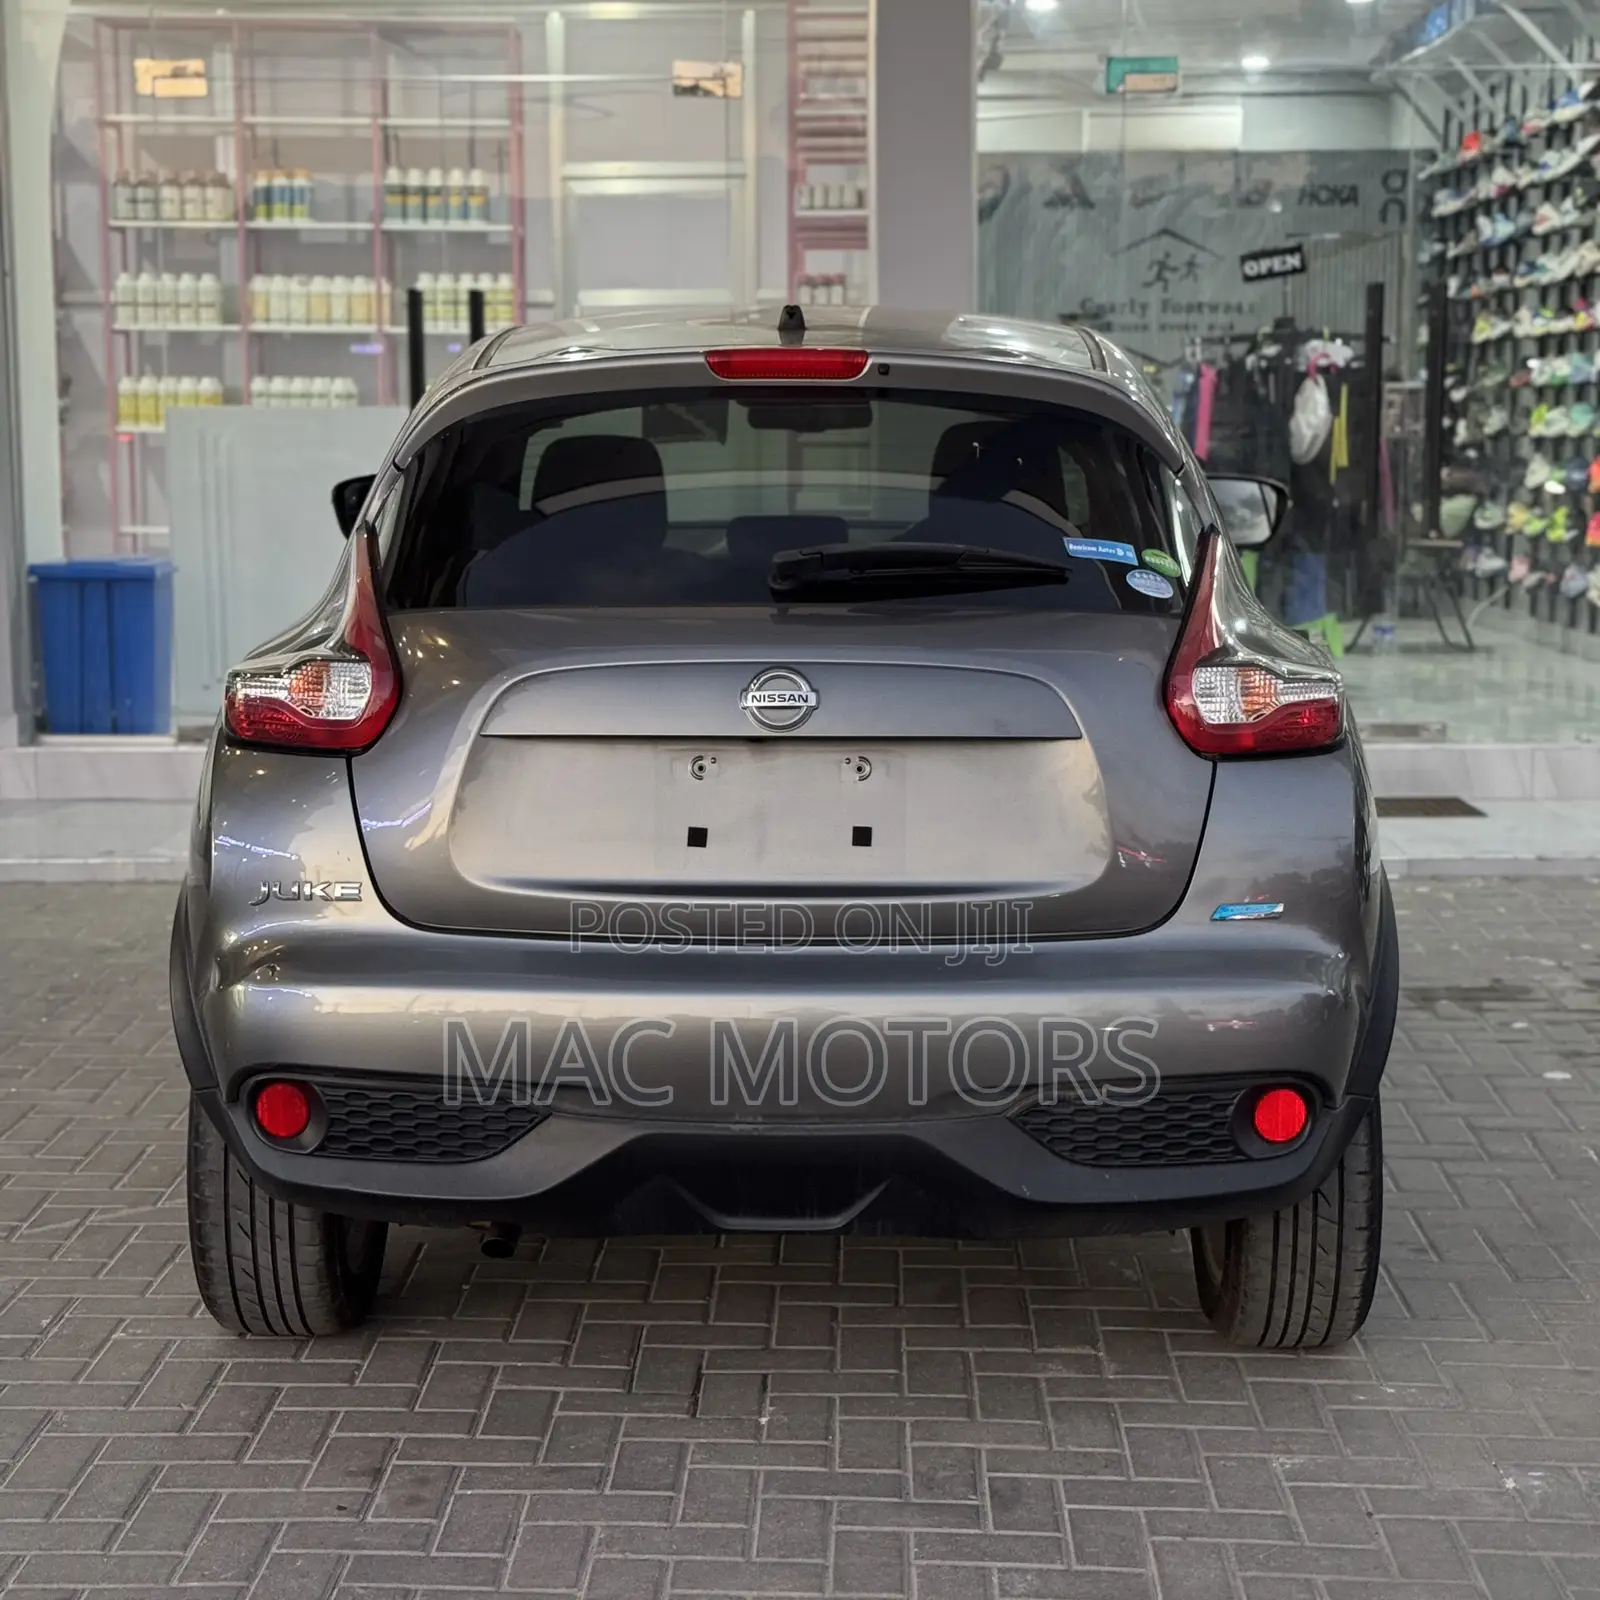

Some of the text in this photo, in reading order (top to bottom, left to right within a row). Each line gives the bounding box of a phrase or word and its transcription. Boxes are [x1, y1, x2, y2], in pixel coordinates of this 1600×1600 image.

[1243, 251, 1302, 277] OPEN
[751, 693, 809, 703] NISSAN
[248, 881, 363, 906] JUKE
